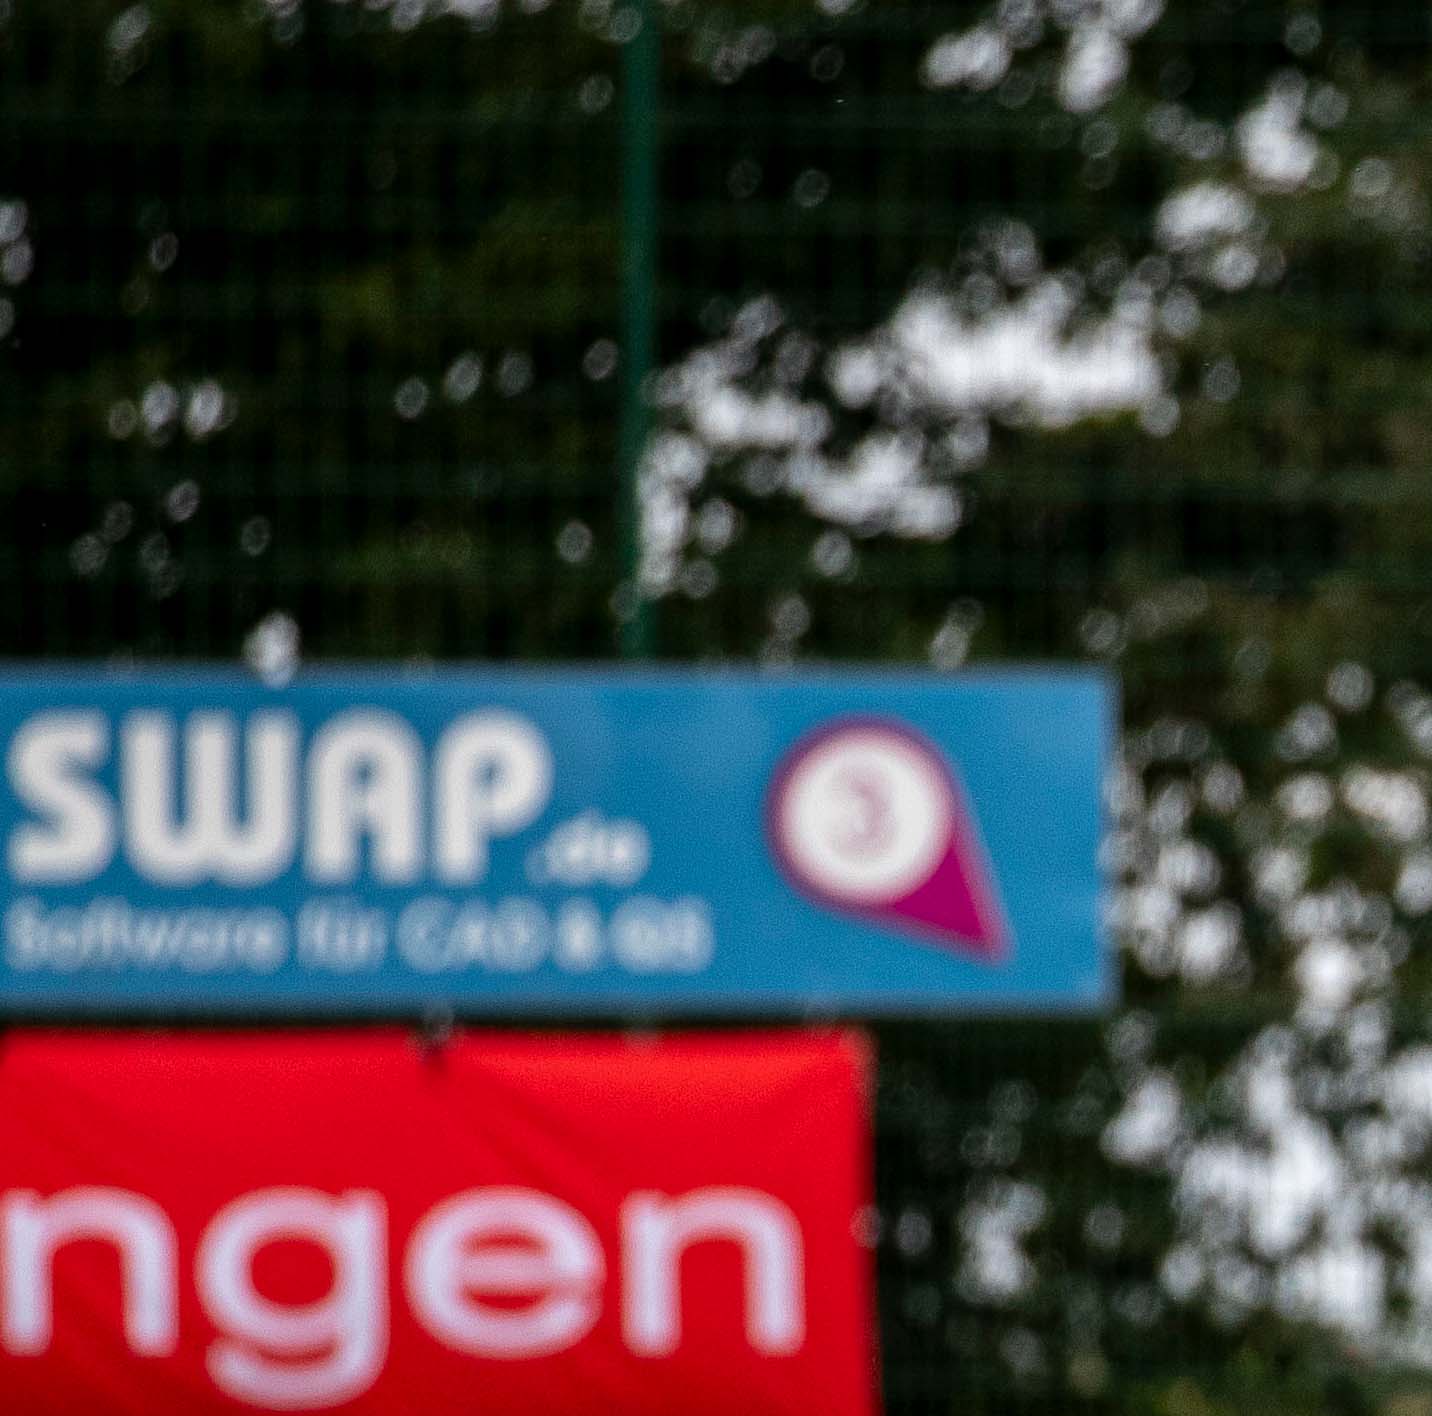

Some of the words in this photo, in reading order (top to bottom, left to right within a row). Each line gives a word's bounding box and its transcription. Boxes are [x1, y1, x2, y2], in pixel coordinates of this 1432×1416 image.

[6, 896, 288, 972] Software
[401, 896, 546, 972] CAD
[0, 1186, 806, 1409] ngen
